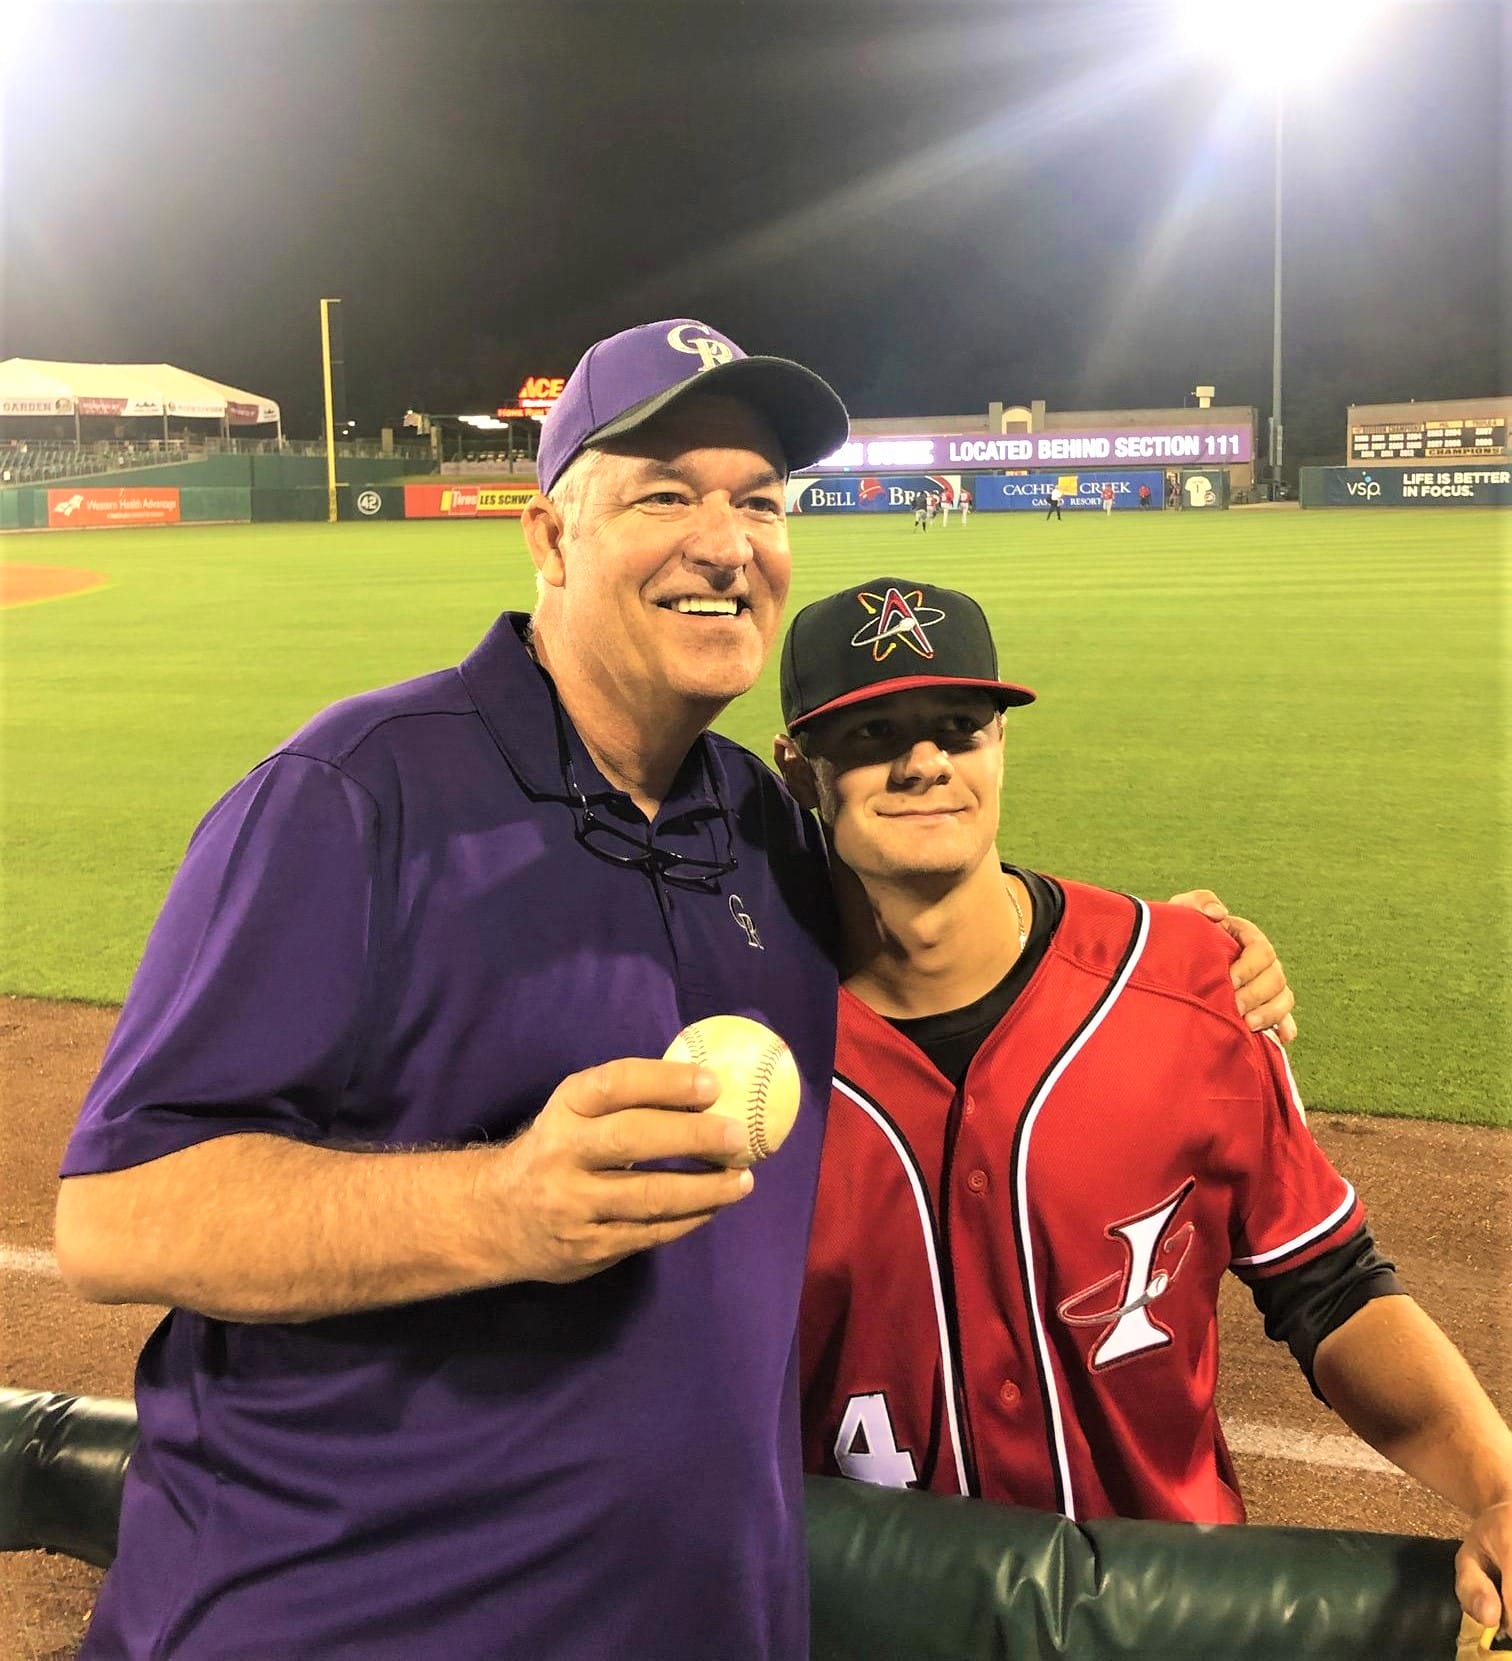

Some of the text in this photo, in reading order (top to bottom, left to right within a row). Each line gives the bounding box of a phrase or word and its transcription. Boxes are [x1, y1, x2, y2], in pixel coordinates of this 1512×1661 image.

[518, 376, 565, 399] ACE
[949, 440, 1033, 462] LOCATED
[1038, 437, 1110, 460] BEHIND
[1114, 434, 1200, 458] SECTION
[1205, 434, 1239, 456] 111
[1403, 471, 1511, 484] LIFE IS BETTER
[1003, 483, 1055, 496] CACHE
[1347, 481, 1381, 500] vsp
[1403, 485, 1474, 497] IN FOCUS.
[361, 496, 376, 509] 42
[452, 491, 477, 508] Tires
[480, 496, 496, 505] LES
[811, 488, 855, 507] BELL
[1032, 497, 1102, 506] CASO RESORT
[87, 498, 176, 512] Western Health Advantage
[833, 1391, 918, 1489] 4
